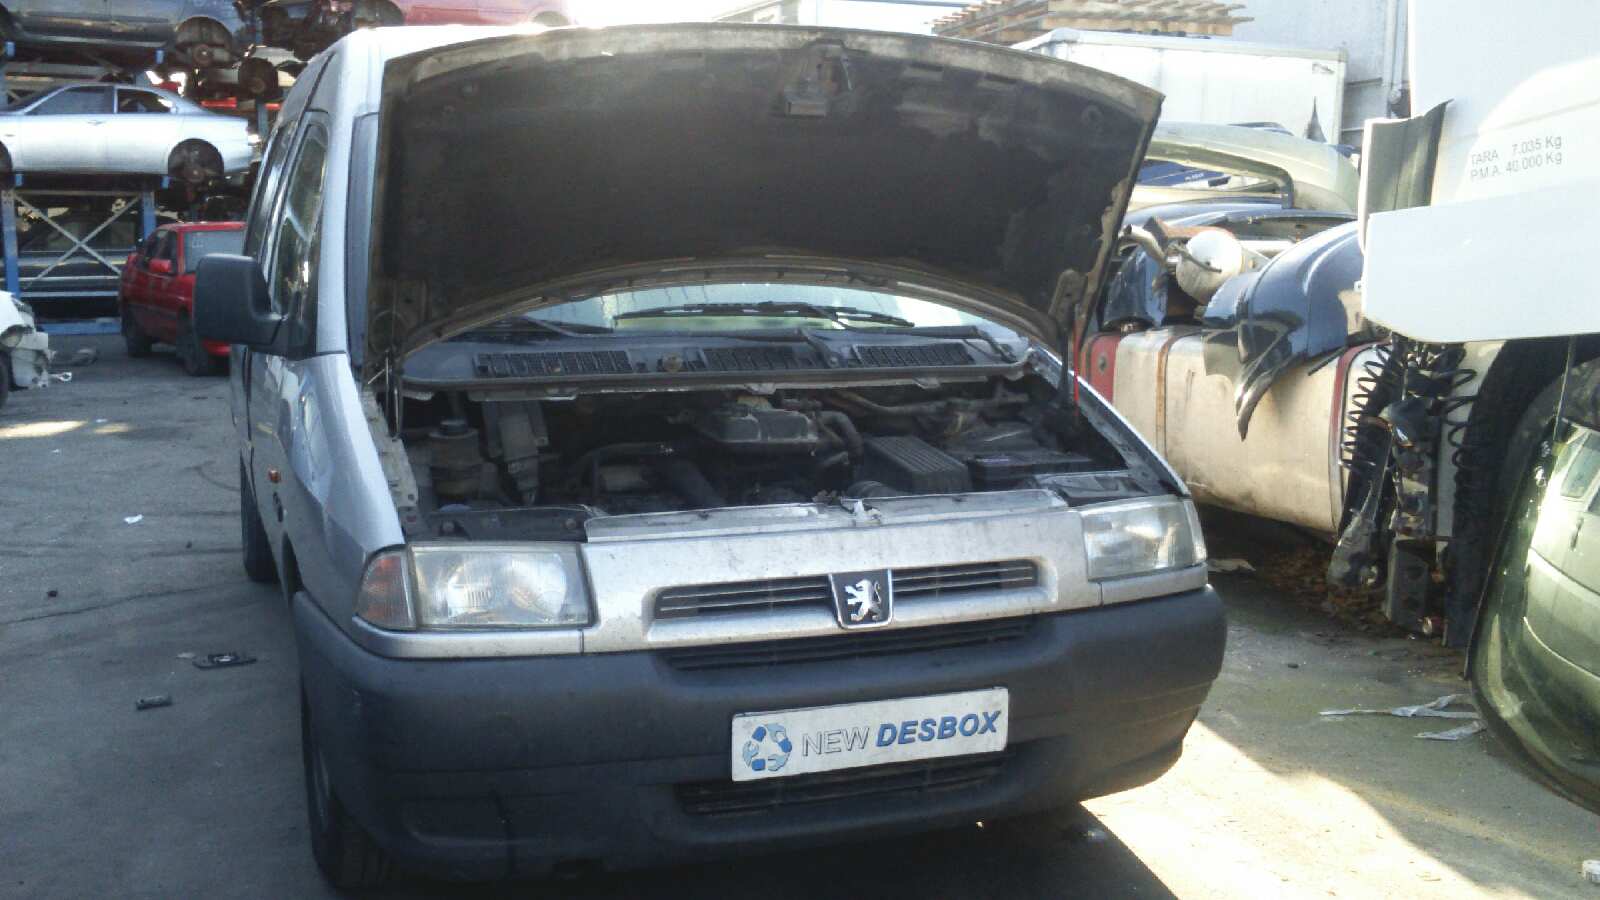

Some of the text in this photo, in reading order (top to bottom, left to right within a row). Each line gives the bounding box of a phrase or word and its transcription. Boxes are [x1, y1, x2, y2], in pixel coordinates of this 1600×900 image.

[1511, 139, 1542, 156] 7.035
[1545, 135, 1562, 149] Kg
[1545, 152, 1562, 165] Kg
[801, 710, 1001, 757] NEW DESBOX
